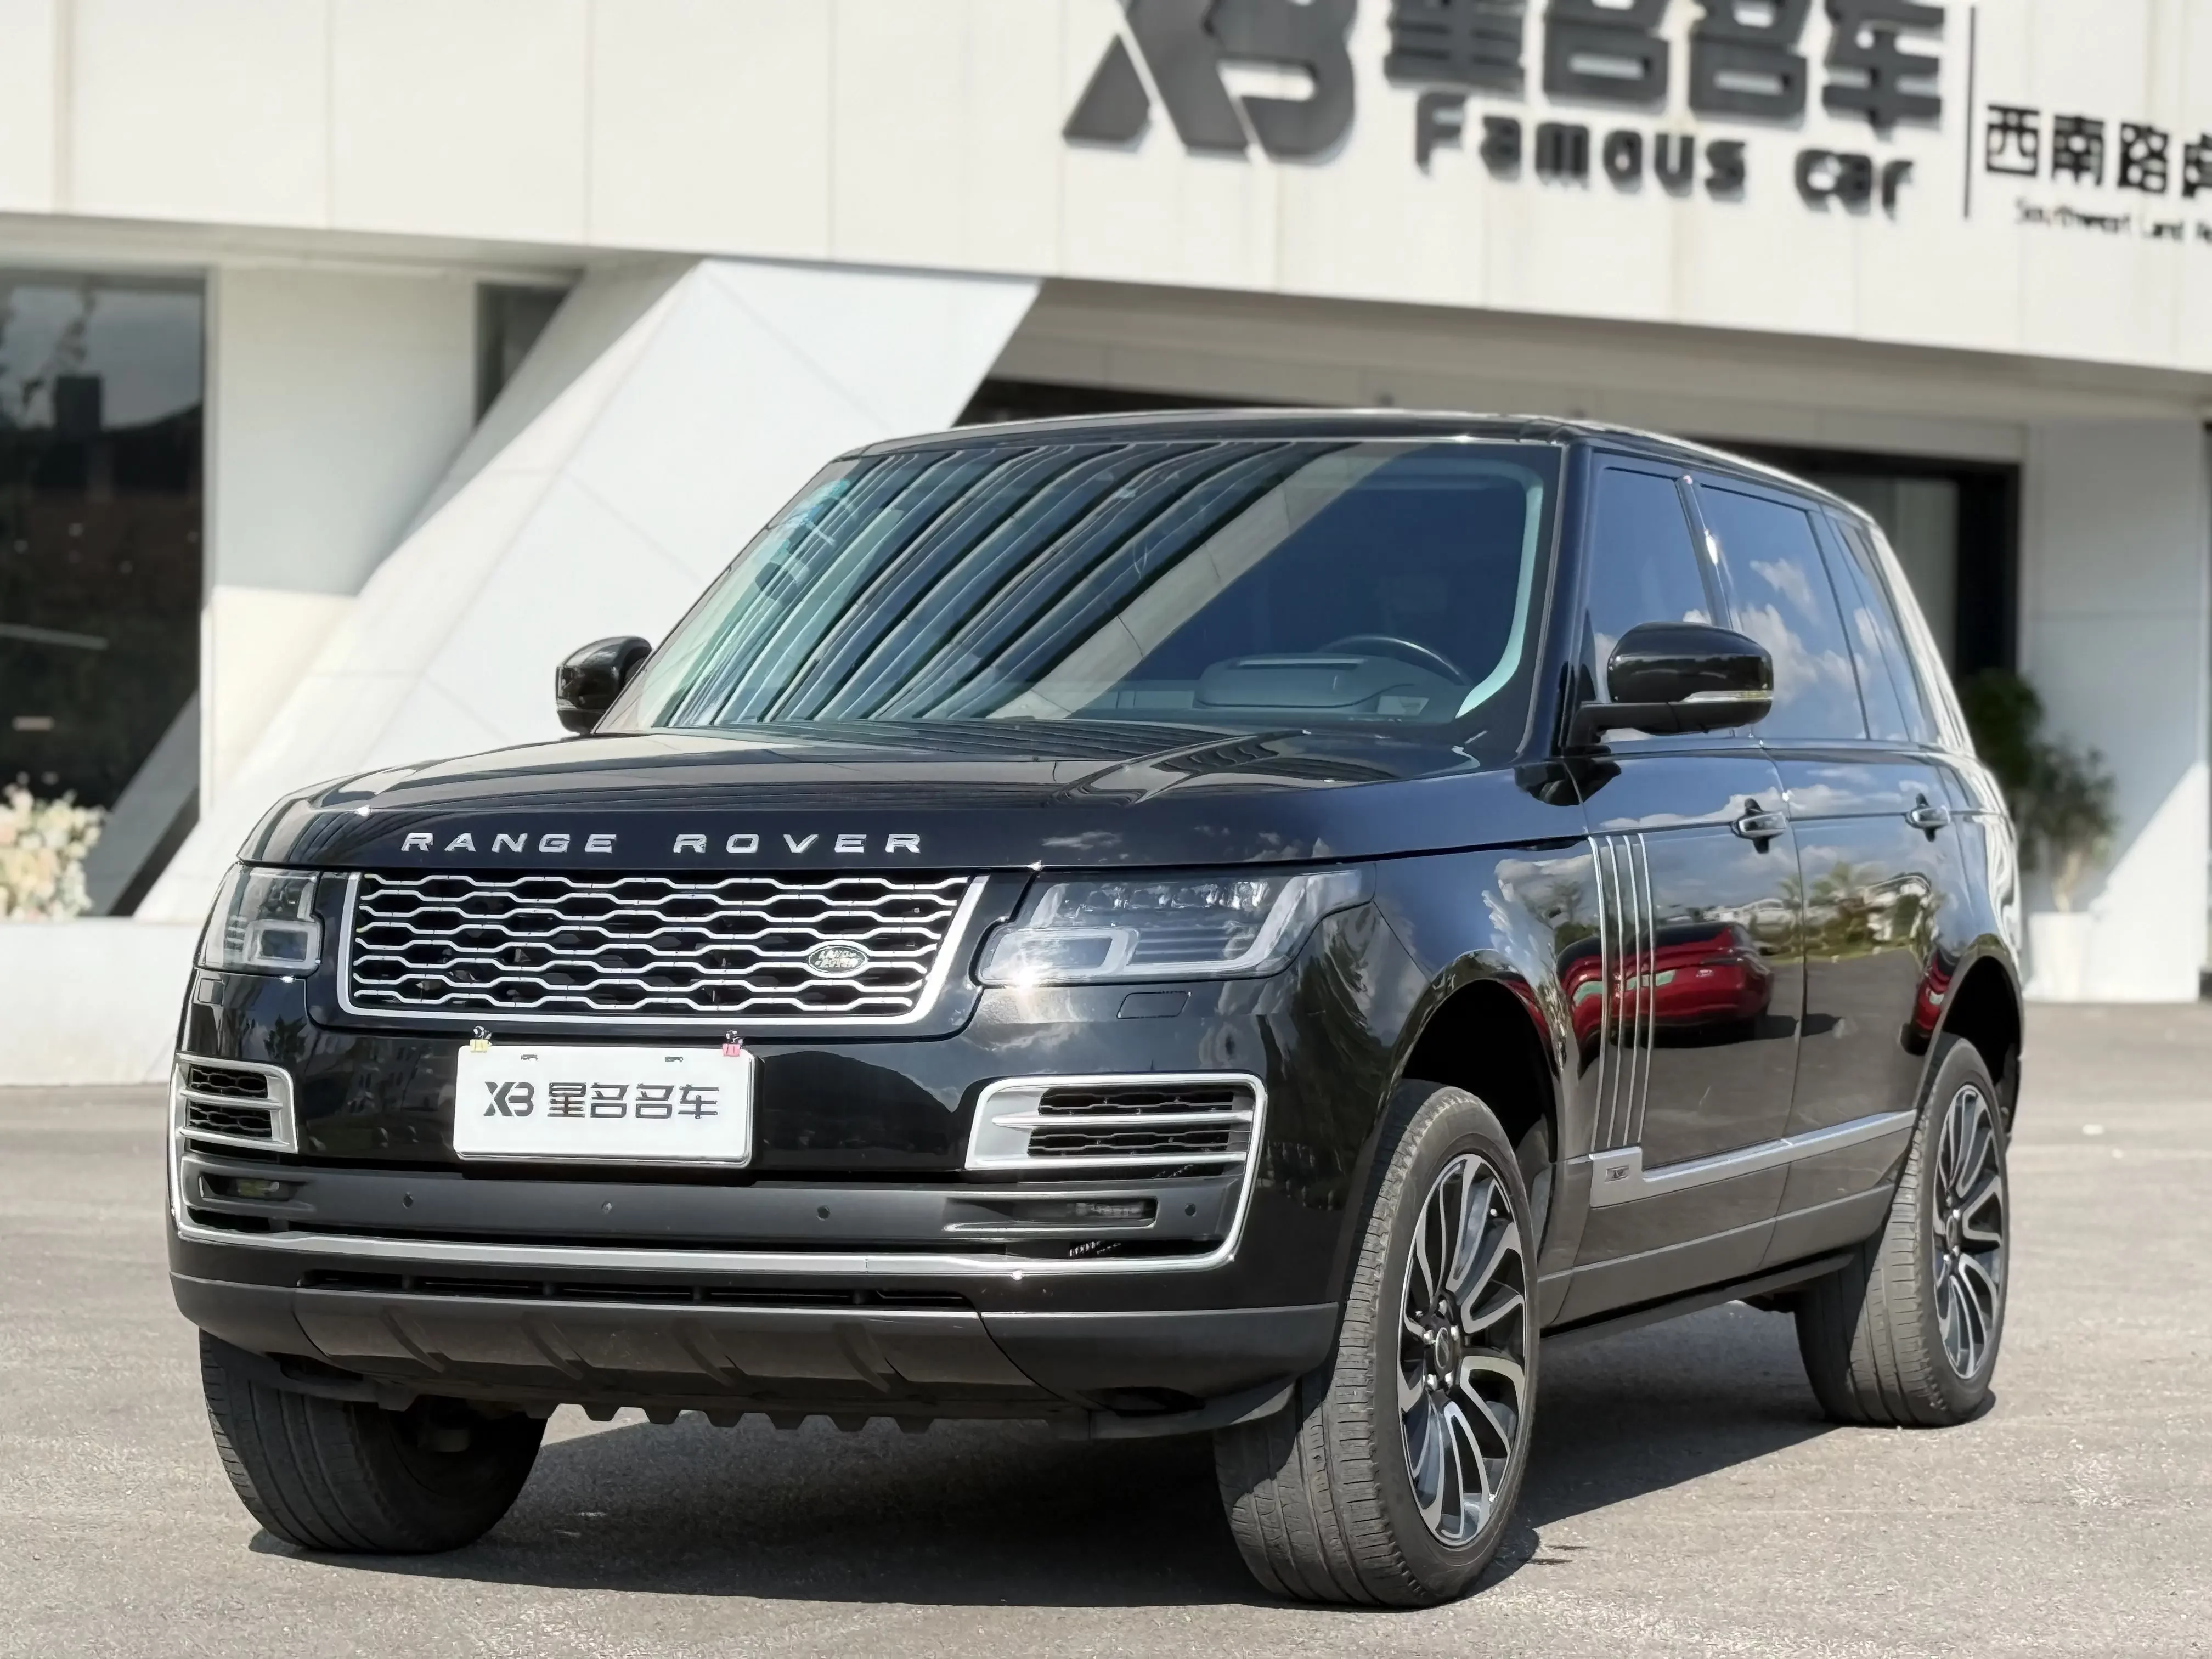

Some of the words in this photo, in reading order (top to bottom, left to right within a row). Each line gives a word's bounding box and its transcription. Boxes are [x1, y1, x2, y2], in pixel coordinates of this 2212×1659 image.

[1415, 91, 1748, 202] Famous
[400, 832, 617, 854] RANGE
[673, 833, 922, 855] ROVER
